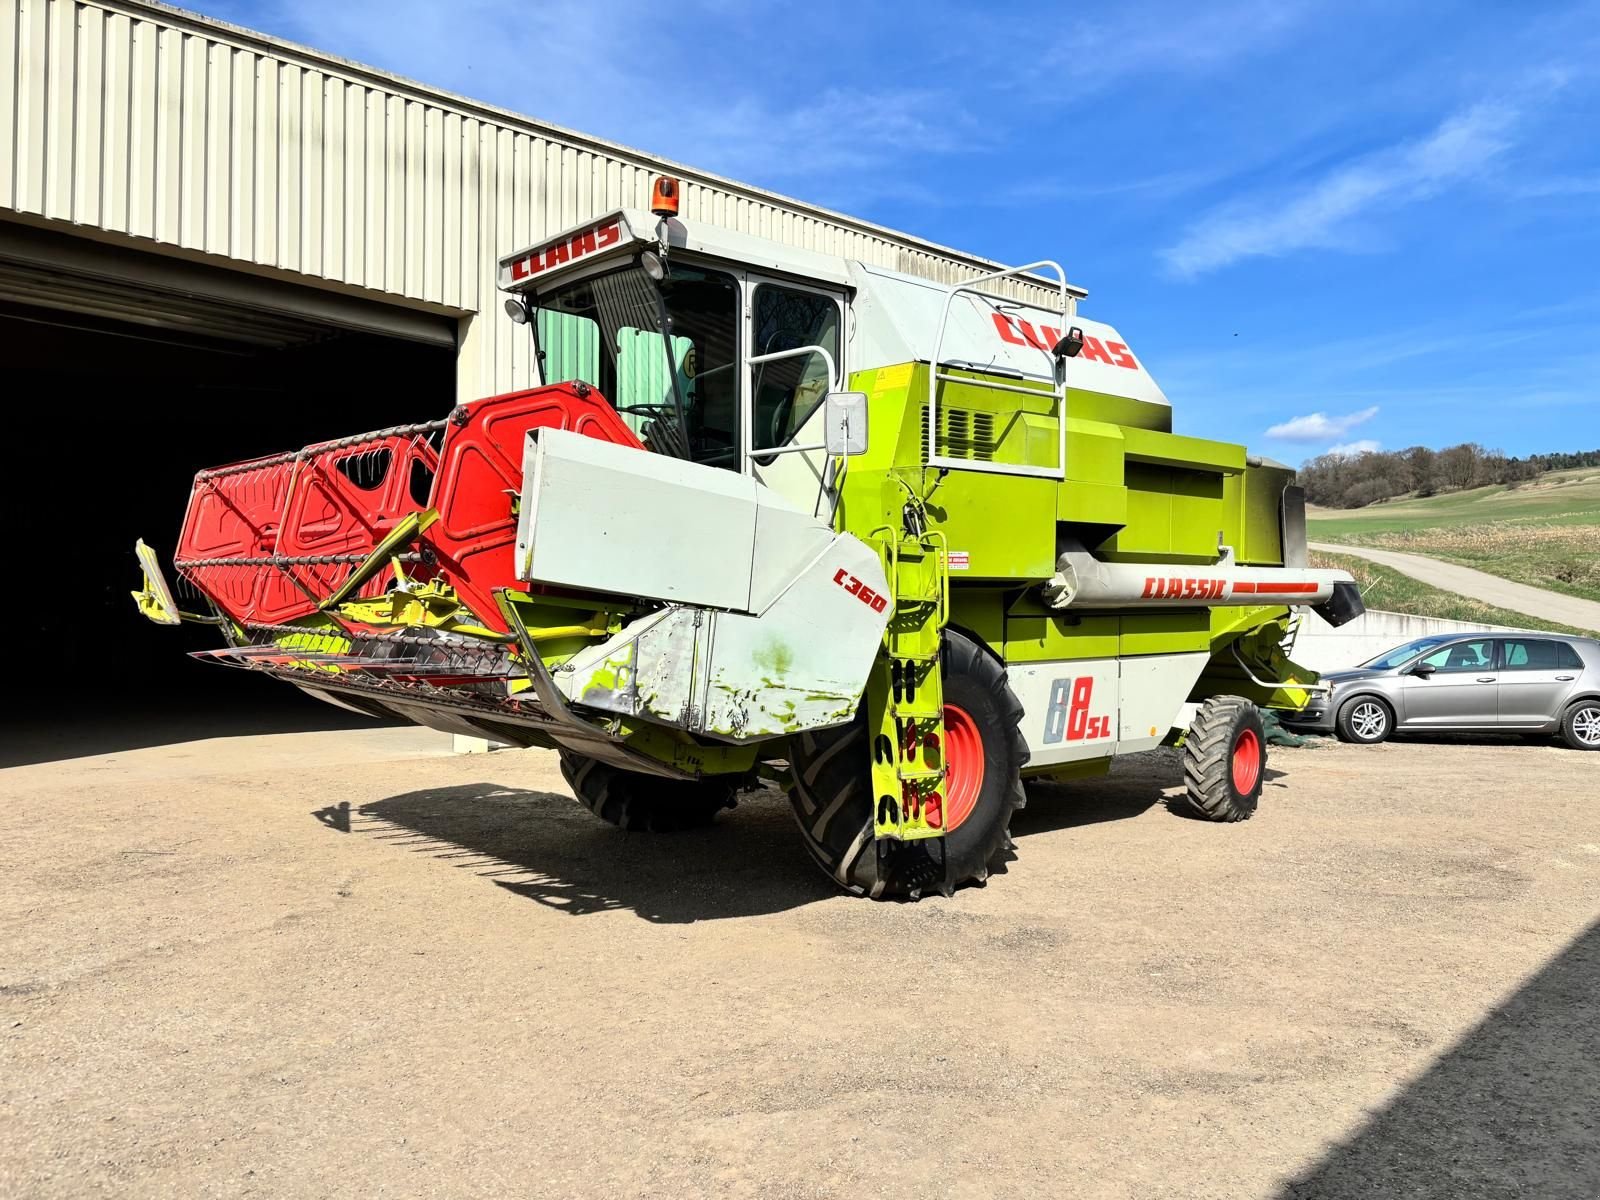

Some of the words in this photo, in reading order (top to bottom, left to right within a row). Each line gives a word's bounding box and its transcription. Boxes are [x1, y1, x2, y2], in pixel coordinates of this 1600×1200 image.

[511, 218, 620, 281] CLAAS
[833, 568, 887, 613] C360
[1140, 577, 1226, 600] CLASSIC
